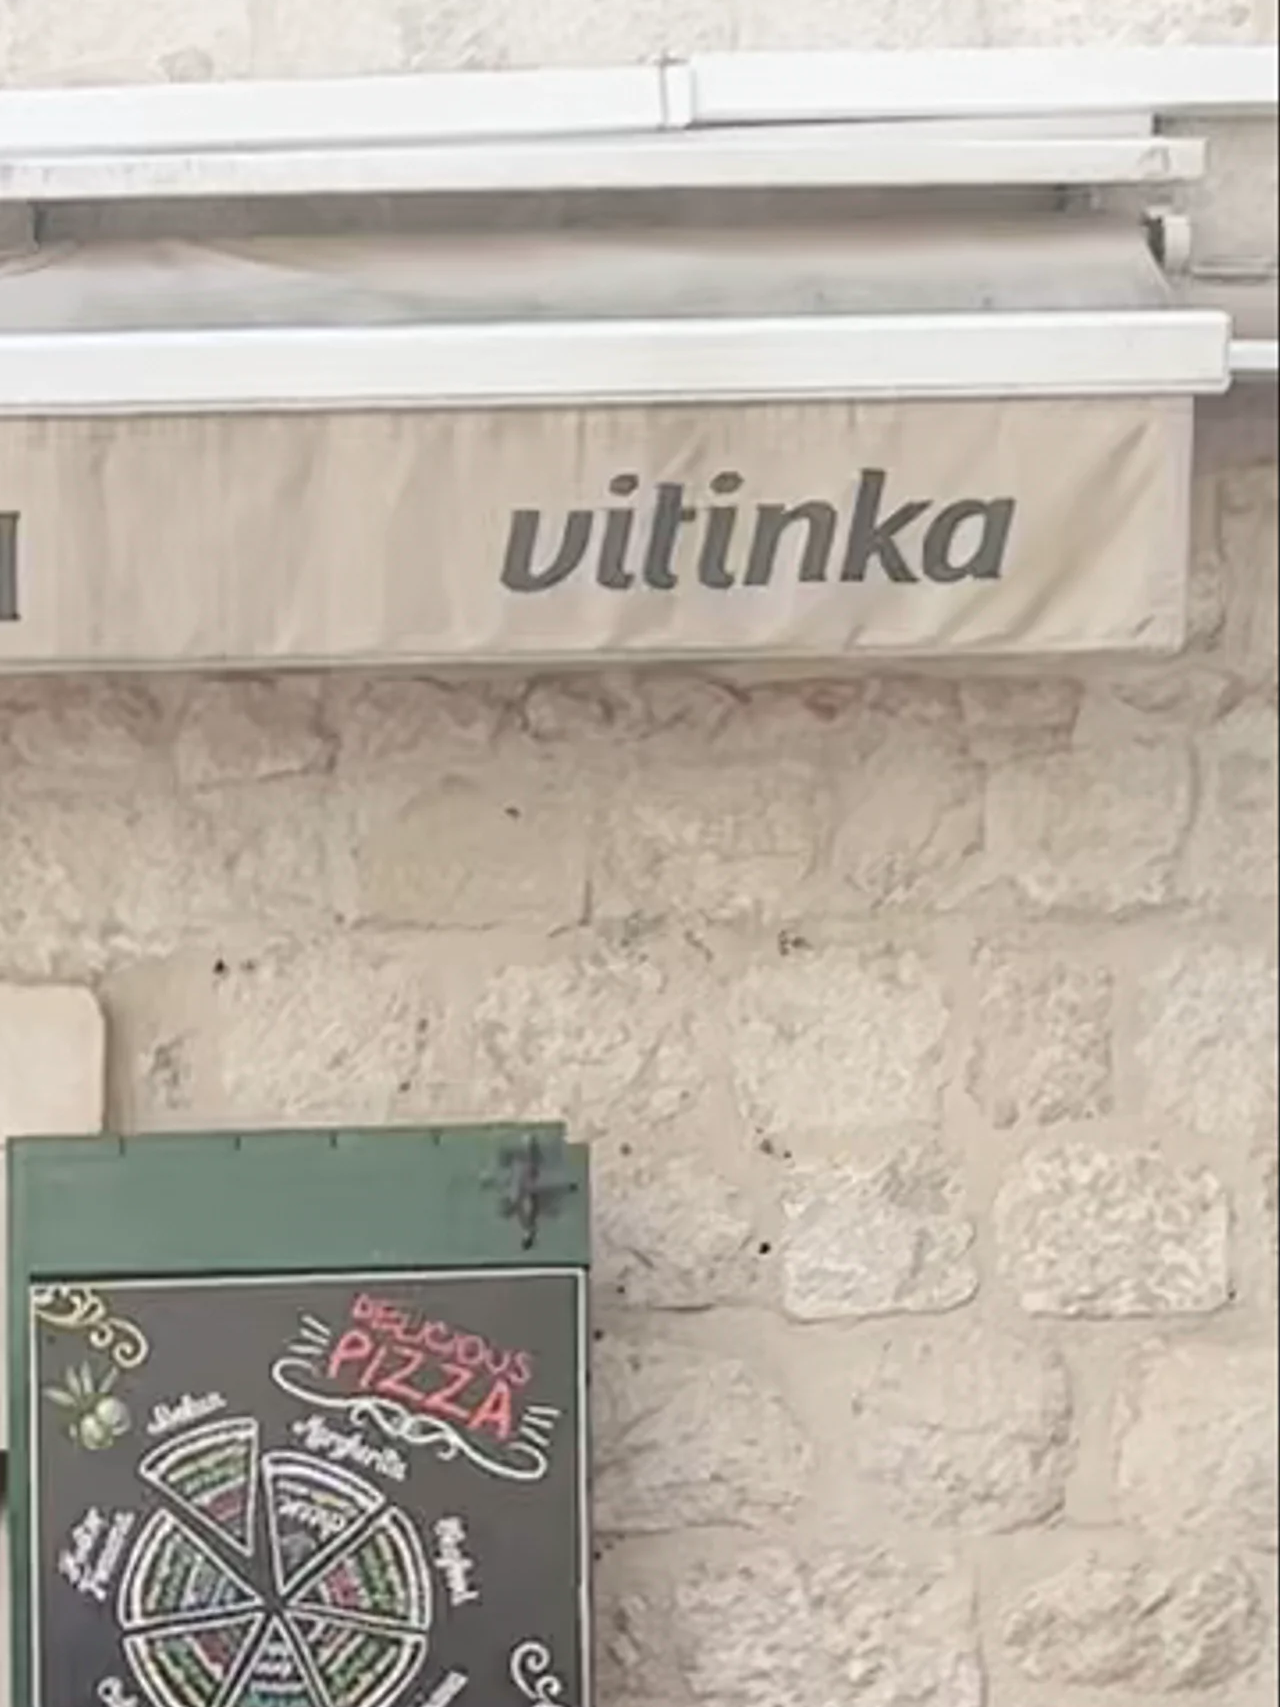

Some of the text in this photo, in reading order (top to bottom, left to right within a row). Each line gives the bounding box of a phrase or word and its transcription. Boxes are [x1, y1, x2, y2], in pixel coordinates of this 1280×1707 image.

[497, 465, 1018, 598] vitinka
[328, 1330, 514, 1439] PIZZA
[352, 1293, 533, 1384] DELICIOUS
